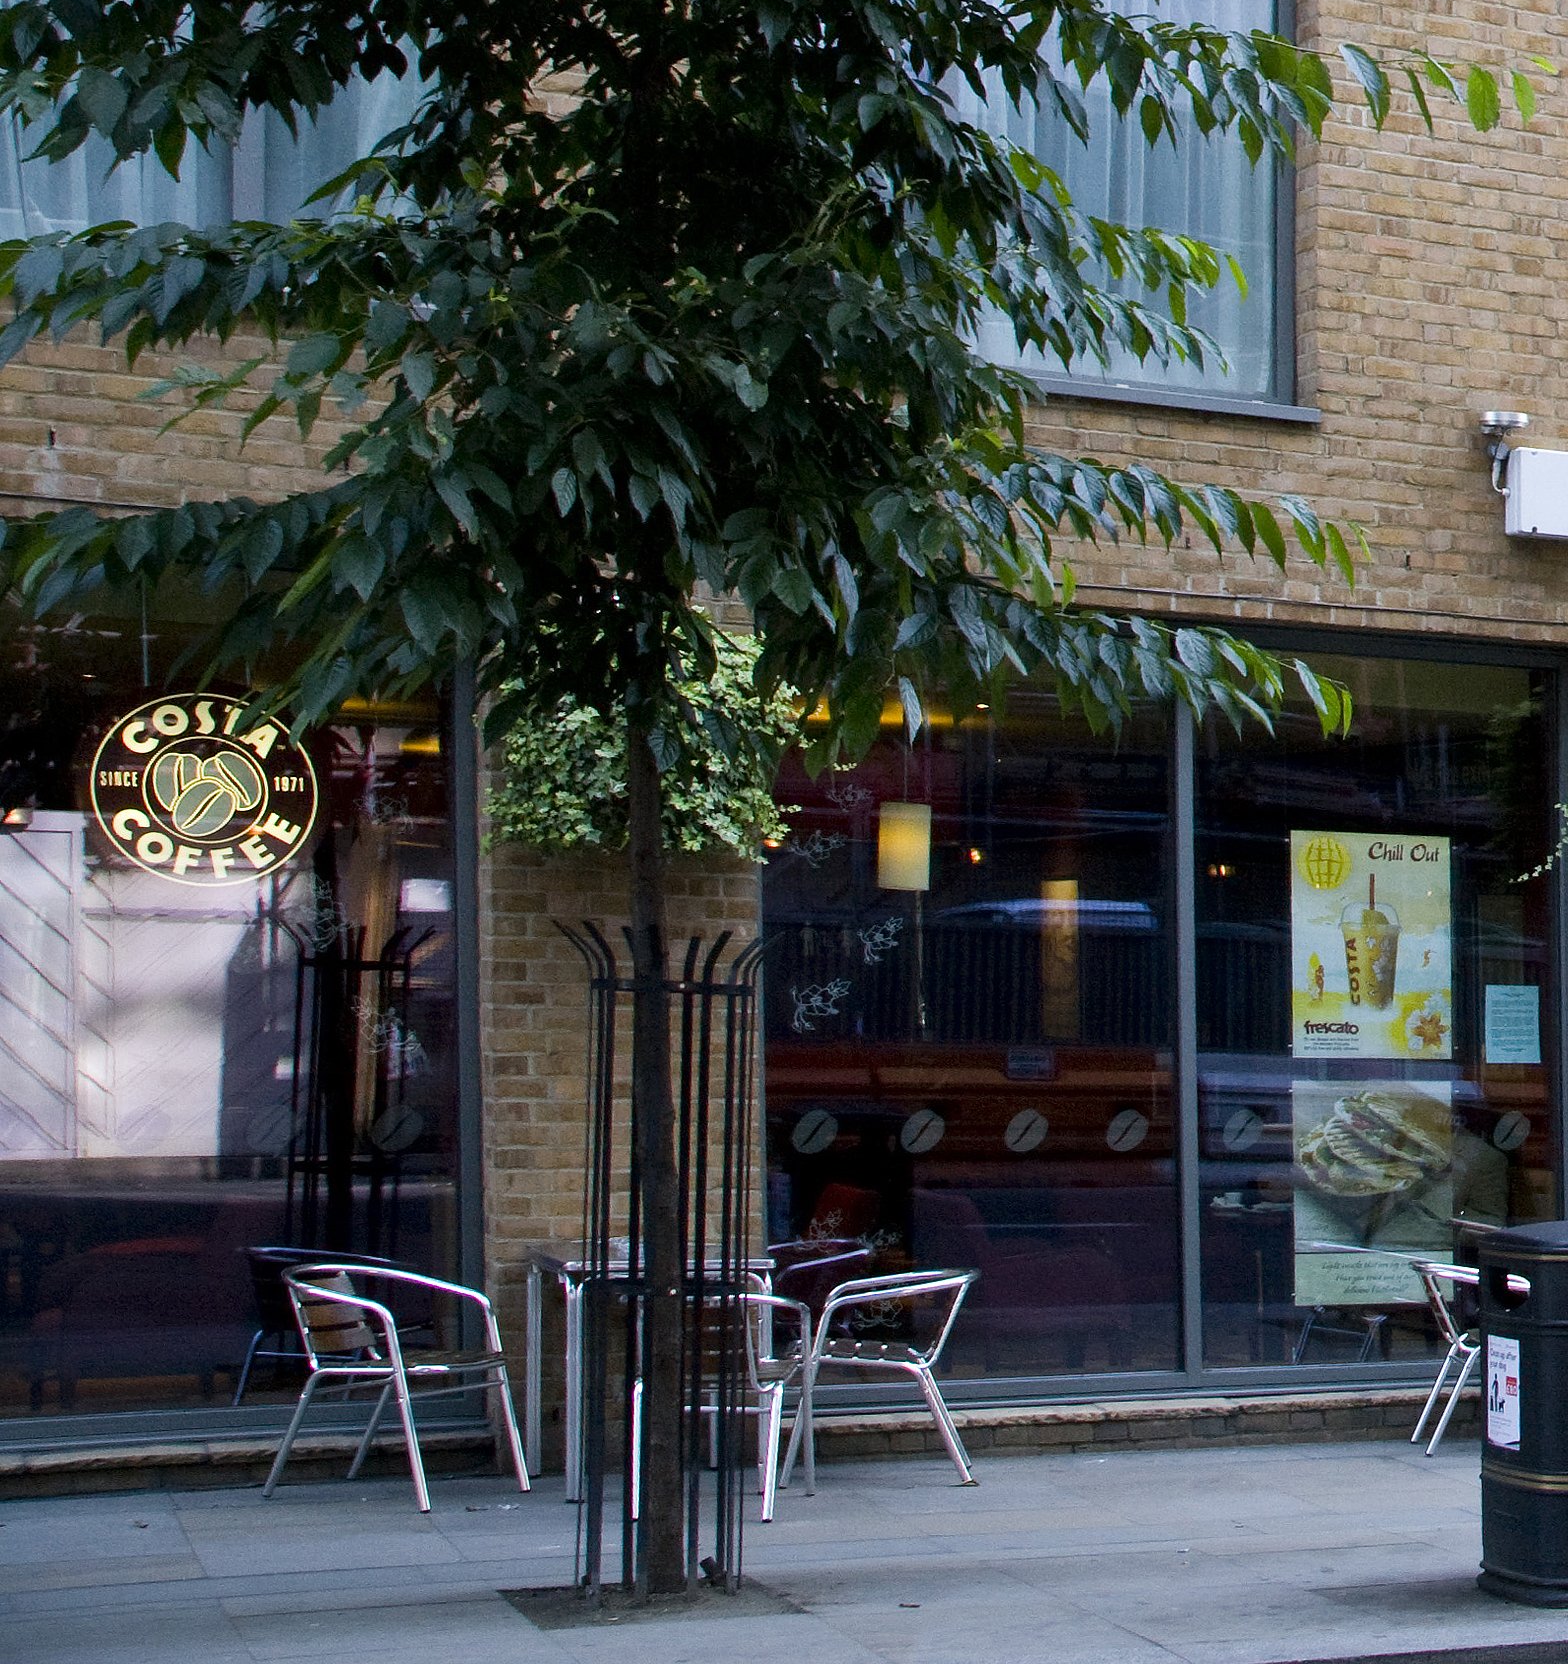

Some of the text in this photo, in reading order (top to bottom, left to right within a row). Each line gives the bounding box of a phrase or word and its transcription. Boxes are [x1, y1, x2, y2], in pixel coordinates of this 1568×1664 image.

[122, 700, 279, 760] COSTA
[100, 771, 138, 787] SINCE
[273, 776, 305, 792] 1971
[112, 808, 302, 879] COFFEE
[1368, 841, 1440, 862] Chill Out
[1303, 1019, 1360, 1035] frescato
